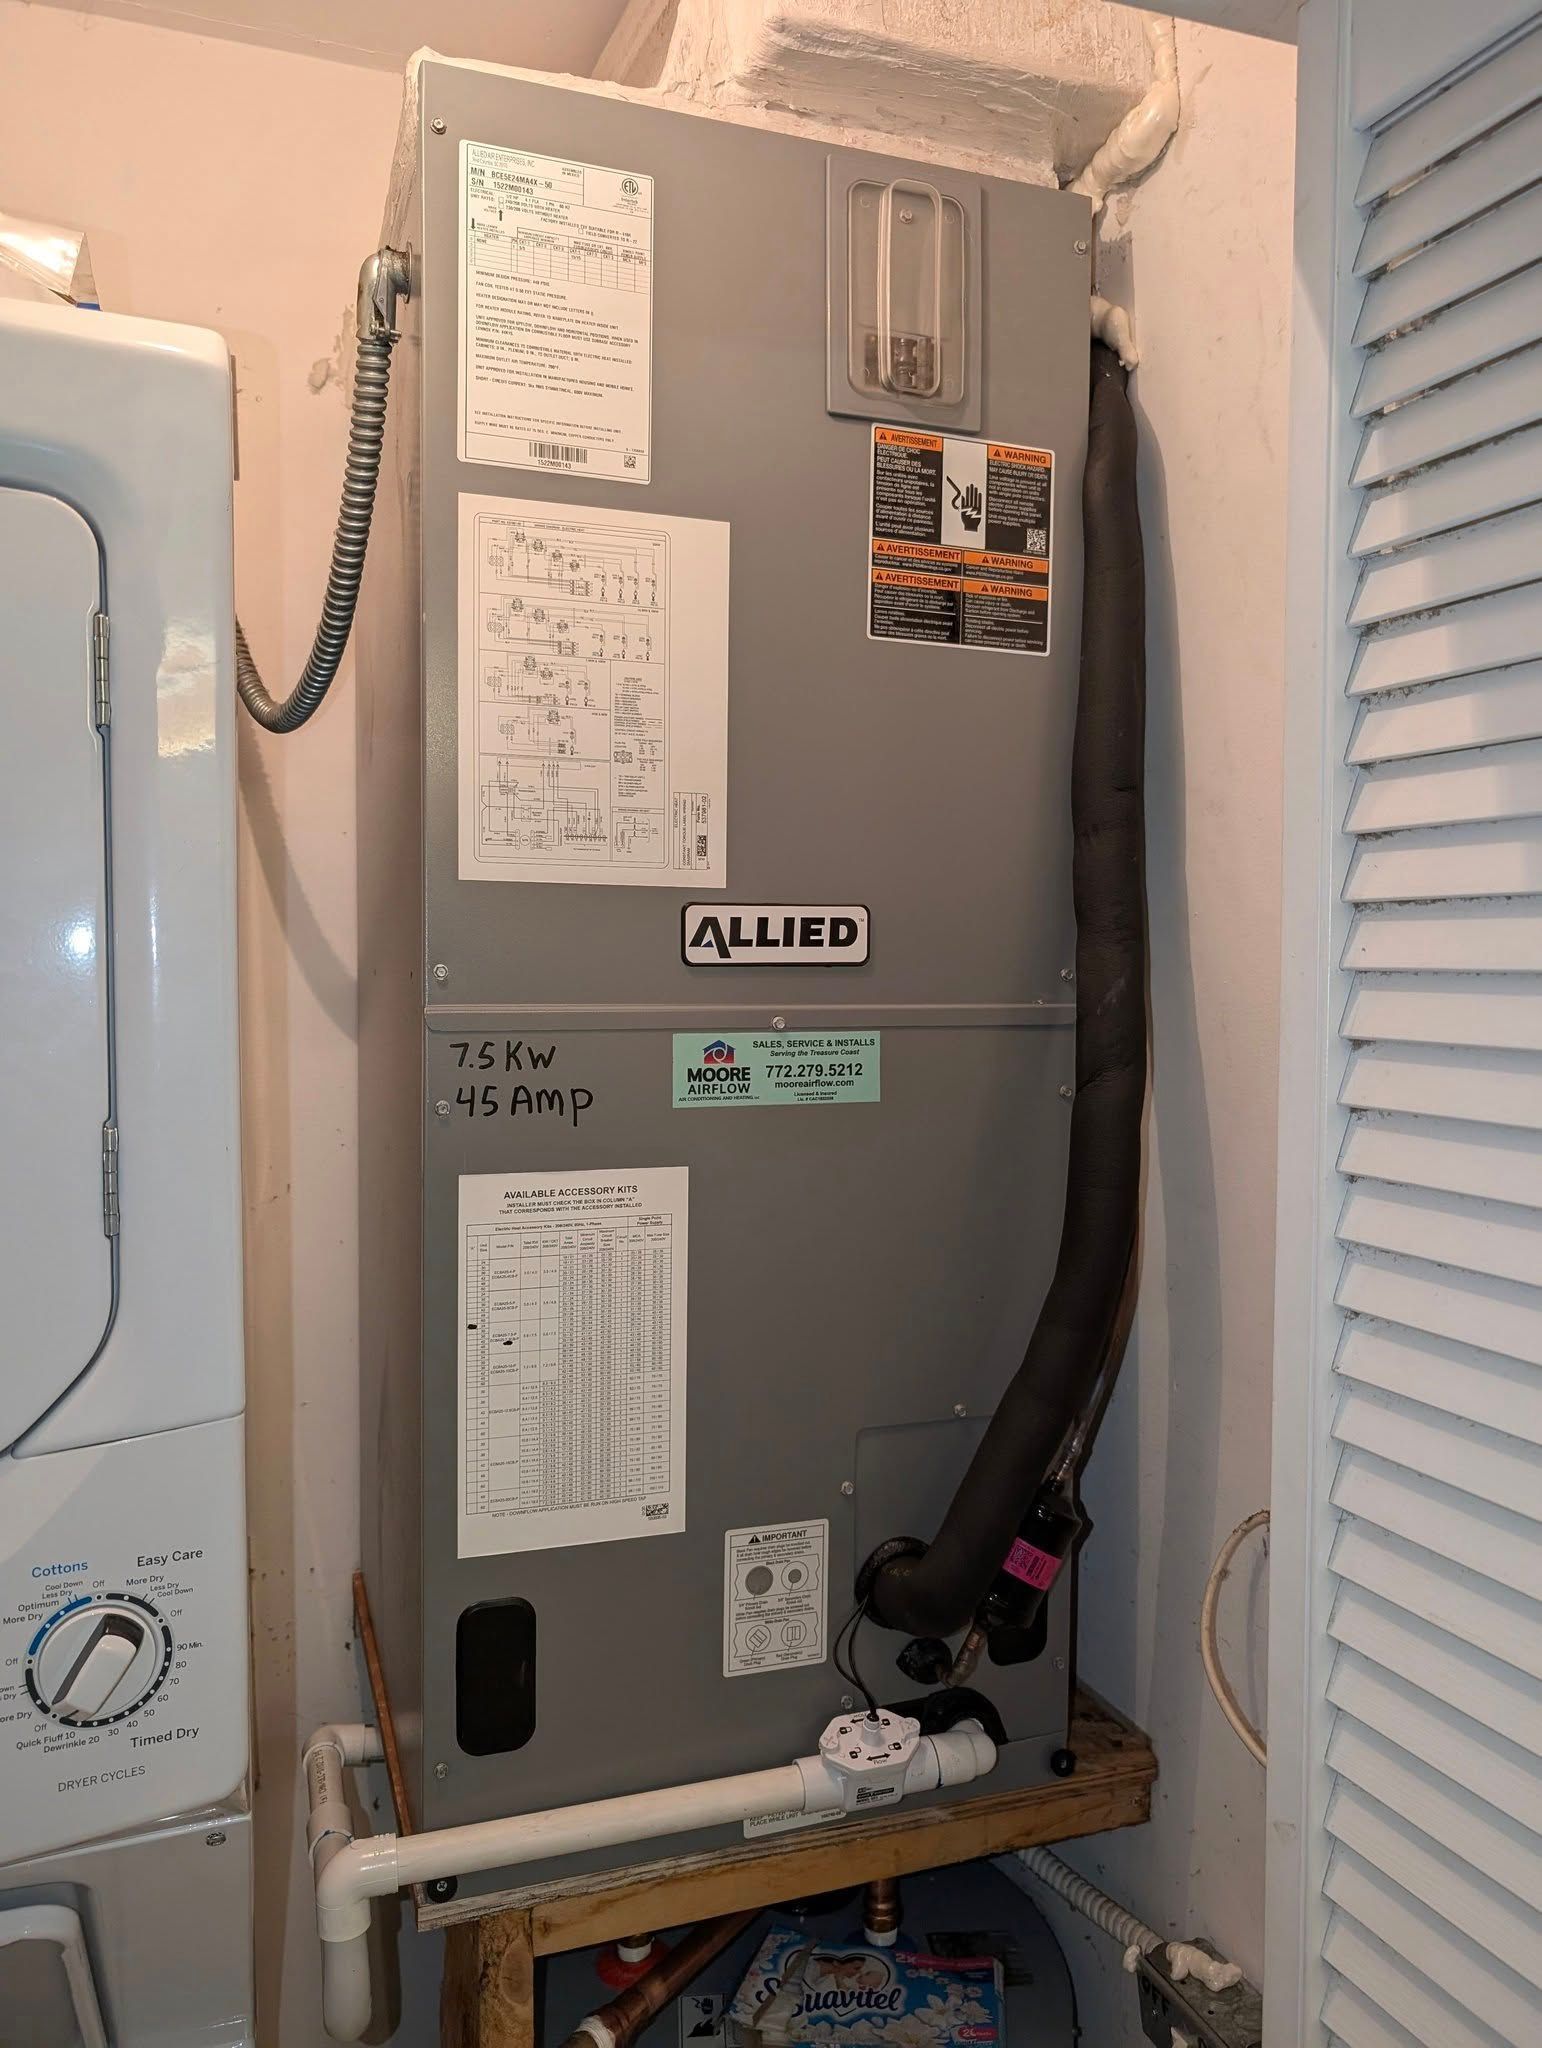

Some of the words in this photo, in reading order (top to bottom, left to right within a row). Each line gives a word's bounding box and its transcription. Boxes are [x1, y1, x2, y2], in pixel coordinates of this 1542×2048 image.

[471, 167, 485, 177] M/N
[472, 178, 484, 187] S/N
[891, 434, 937, 447] AVERTISSEMENT
[1005, 450, 1046, 464] WARNING
[538, 460, 572, 470] 1522M00143
[887, 544, 960, 560] AVERTISSEMENT
[991, 557, 1033, 569] WARNING
[885, 573, 959, 589] AVERTISSEMENT
[990, 585, 1032, 597] WARNING
[688, 917, 858, 959] ALLIED
[753, 1040, 785, 1049] SALES,
[787, 1040, 824, 1048] SERVICE
[835, 1039, 875, 1047] INSTALLS
[450, 1042, 495, 1070] 7.5
[688, 1067, 751, 1082] MOORE
[766, 1063, 863, 1078] 772.279.5212
[688, 1083, 751, 1095] AIRFLOW
[775, 1080, 854, 1088] mooreairflow.com
[456, 1085, 498, 1117] 45
[504, 1189, 556, 1199] AVAILABLE
[558, 1186, 615, 1197] ACCESSORY
[618, 1185, 638, 1194] KITS
[509, 1508, 539, 1516] DOWNFLOW
[762, 1530, 808, 1542] IMPORTANT
[138, 1555, 168, 1567] Easy
[172, 1550, 203, 1562] Care
[32, 1562, 88, 1578] Cottons
[64, 1580, 83, 1589] Down
[92, 1580, 105, 1588] Off
[126, 1578, 148, 1586] More
[150, 1575, 164, 1583] Dry
[42, 1592, 58, 1600] Less
[157, 1590, 173, 1598] Cool
[175, 1587, 194, 1595] Down
[18, 1600, 60, 1612] Optimum
[170, 1609, 183, 1617] Off
[3, 1616, 26, 1625] More
[28, 1613, 43, 1621] Dry
[177, 1643, 188, 1651] 90
[189, 1642, 203, 1650] Min.
[6, 1658, 18, 1667] Off
[176, 1661, 187, 1669] 80
[169, 1678, 180, 1686] 70
[4, 1693, 17, 1701] Dry
[157, 1694, 169, 1702] 60
[17, 1711, 32, 1719] Dry
[144, 1709, 155, 1717] 50
[34, 1723, 48, 1732] Off
[126, 1720, 138, 1728] 40
[108, 1728, 120, 1737] 30
[130, 1730, 173, 1748] Timed
[177, 1728, 200, 1739] Dry
[16, 1739, 42, 1750] Quick
[44, 1734, 64, 1744] Fluff
[65, 1732, 76, 1740] 10
[44, 1739, 87, 1753] Dewrinkle
[89, 1736, 100, 1744] 20
[58, 1776, 98, 1792] DRYER
[101, 1766, 146, 1783] CYCLES
[750, 1819, 768, 1827] PLACE
